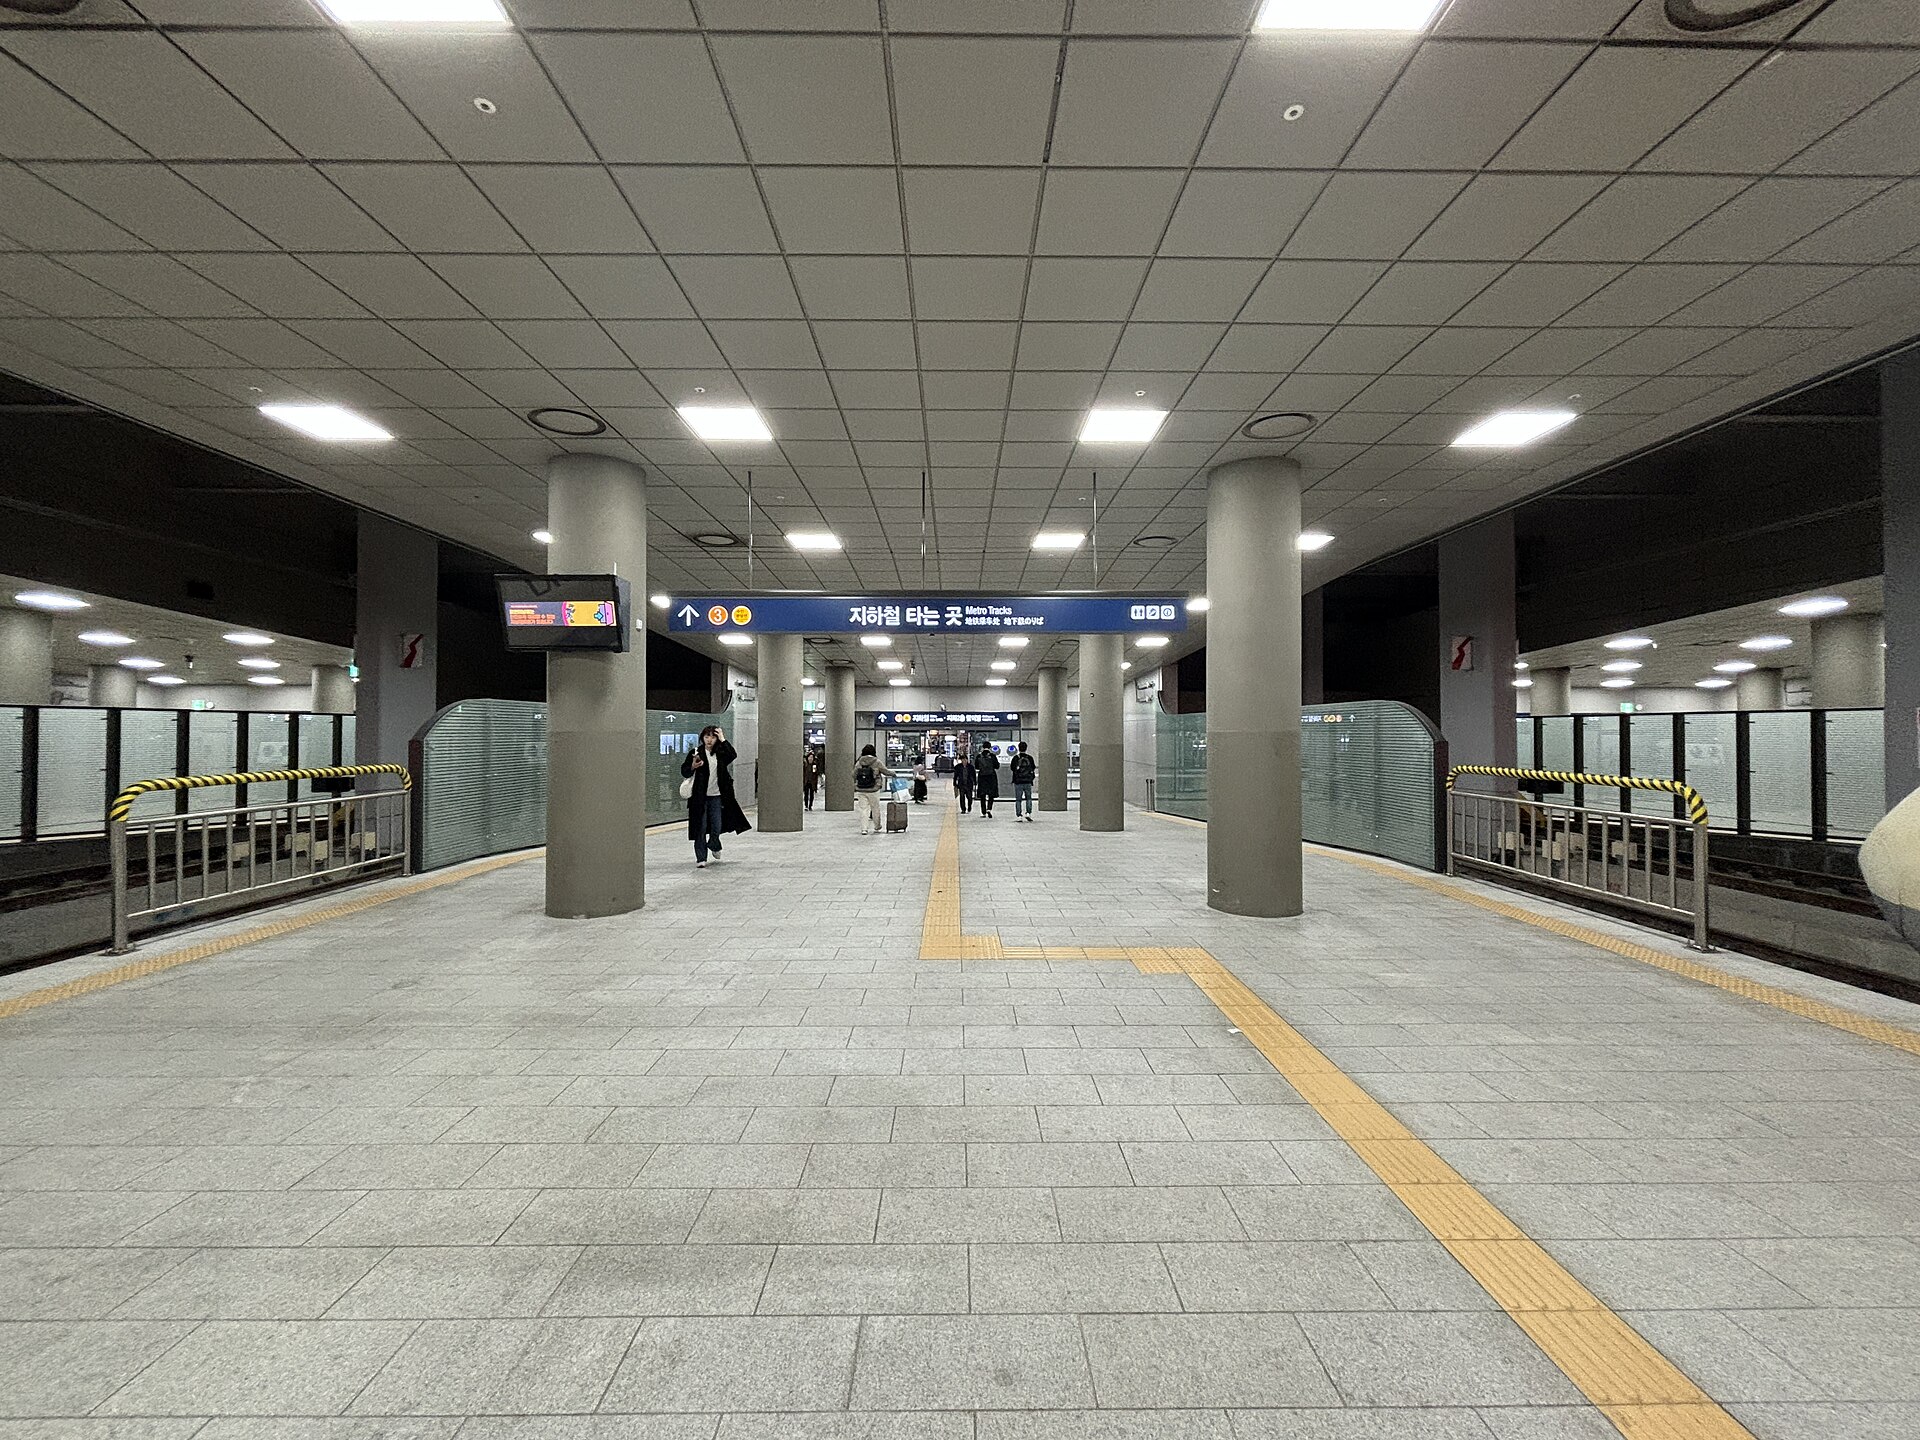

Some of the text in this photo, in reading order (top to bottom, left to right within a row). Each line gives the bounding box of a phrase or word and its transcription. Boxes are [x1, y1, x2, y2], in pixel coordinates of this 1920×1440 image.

[713, 609, 722, 622] 3
[849, 606, 962, 626] 지하철 타는 곳
[965, 606, 1012, 615] Metro Tracks
